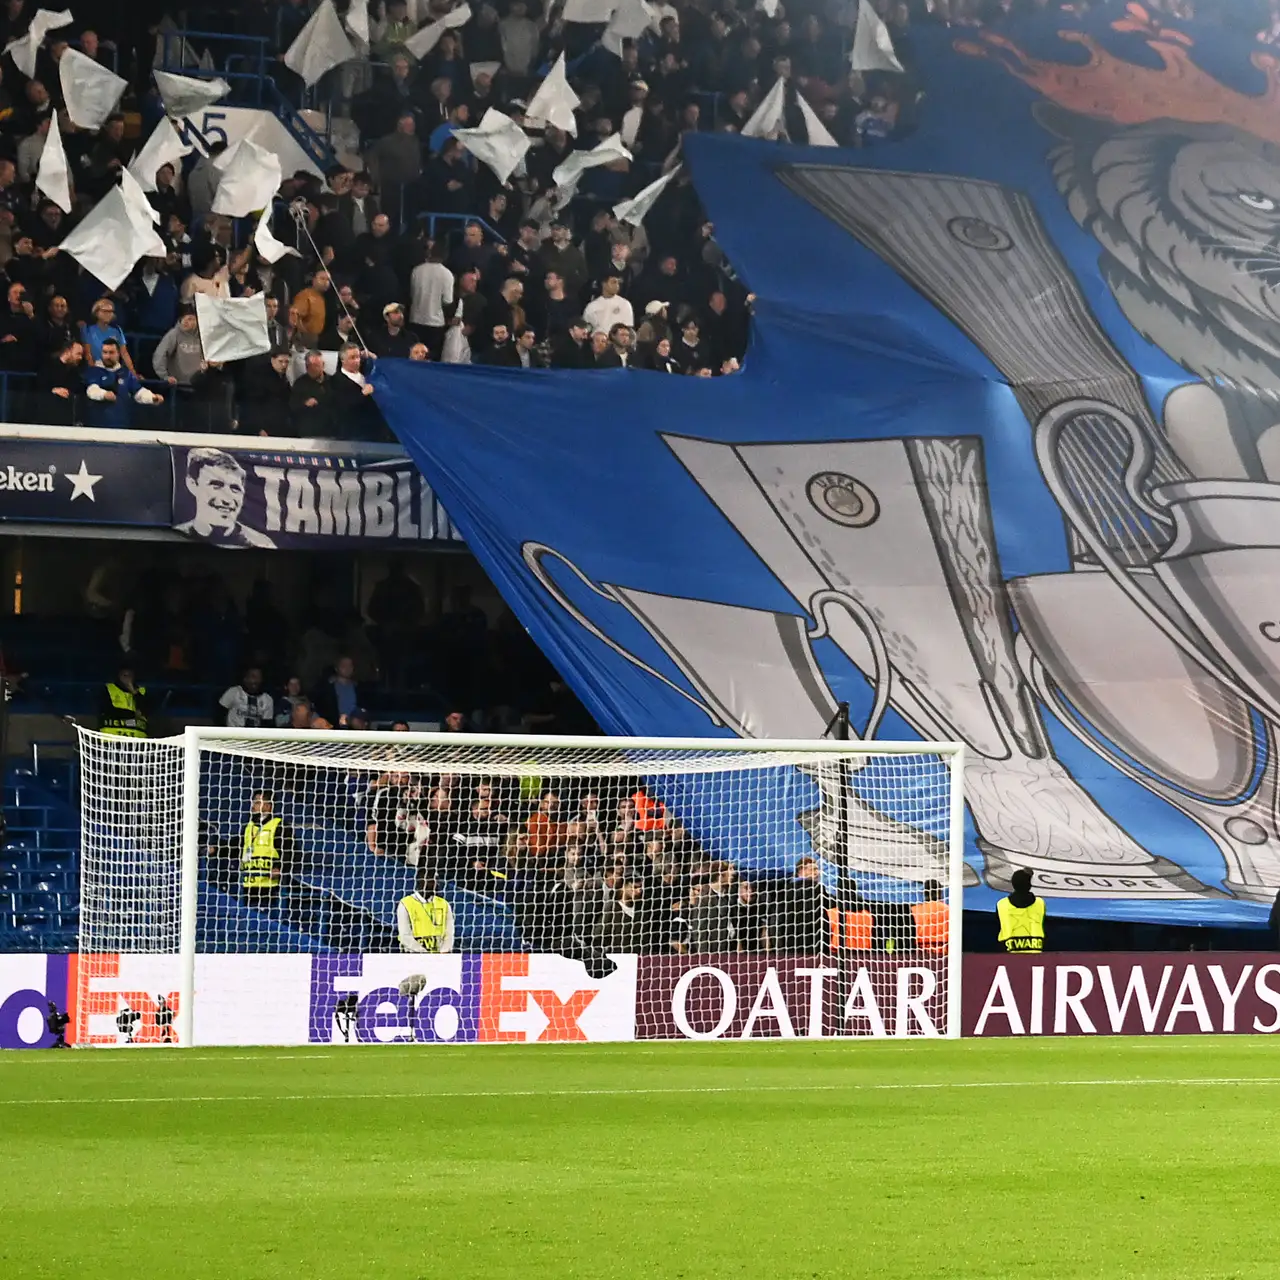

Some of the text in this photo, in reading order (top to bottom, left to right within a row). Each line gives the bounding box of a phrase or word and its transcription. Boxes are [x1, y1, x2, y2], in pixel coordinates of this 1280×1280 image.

[1038, 874, 1164, 889] COUPE
[308, 953, 599, 1042] FedEx
[672, 966, 938, 1039] QATAR
